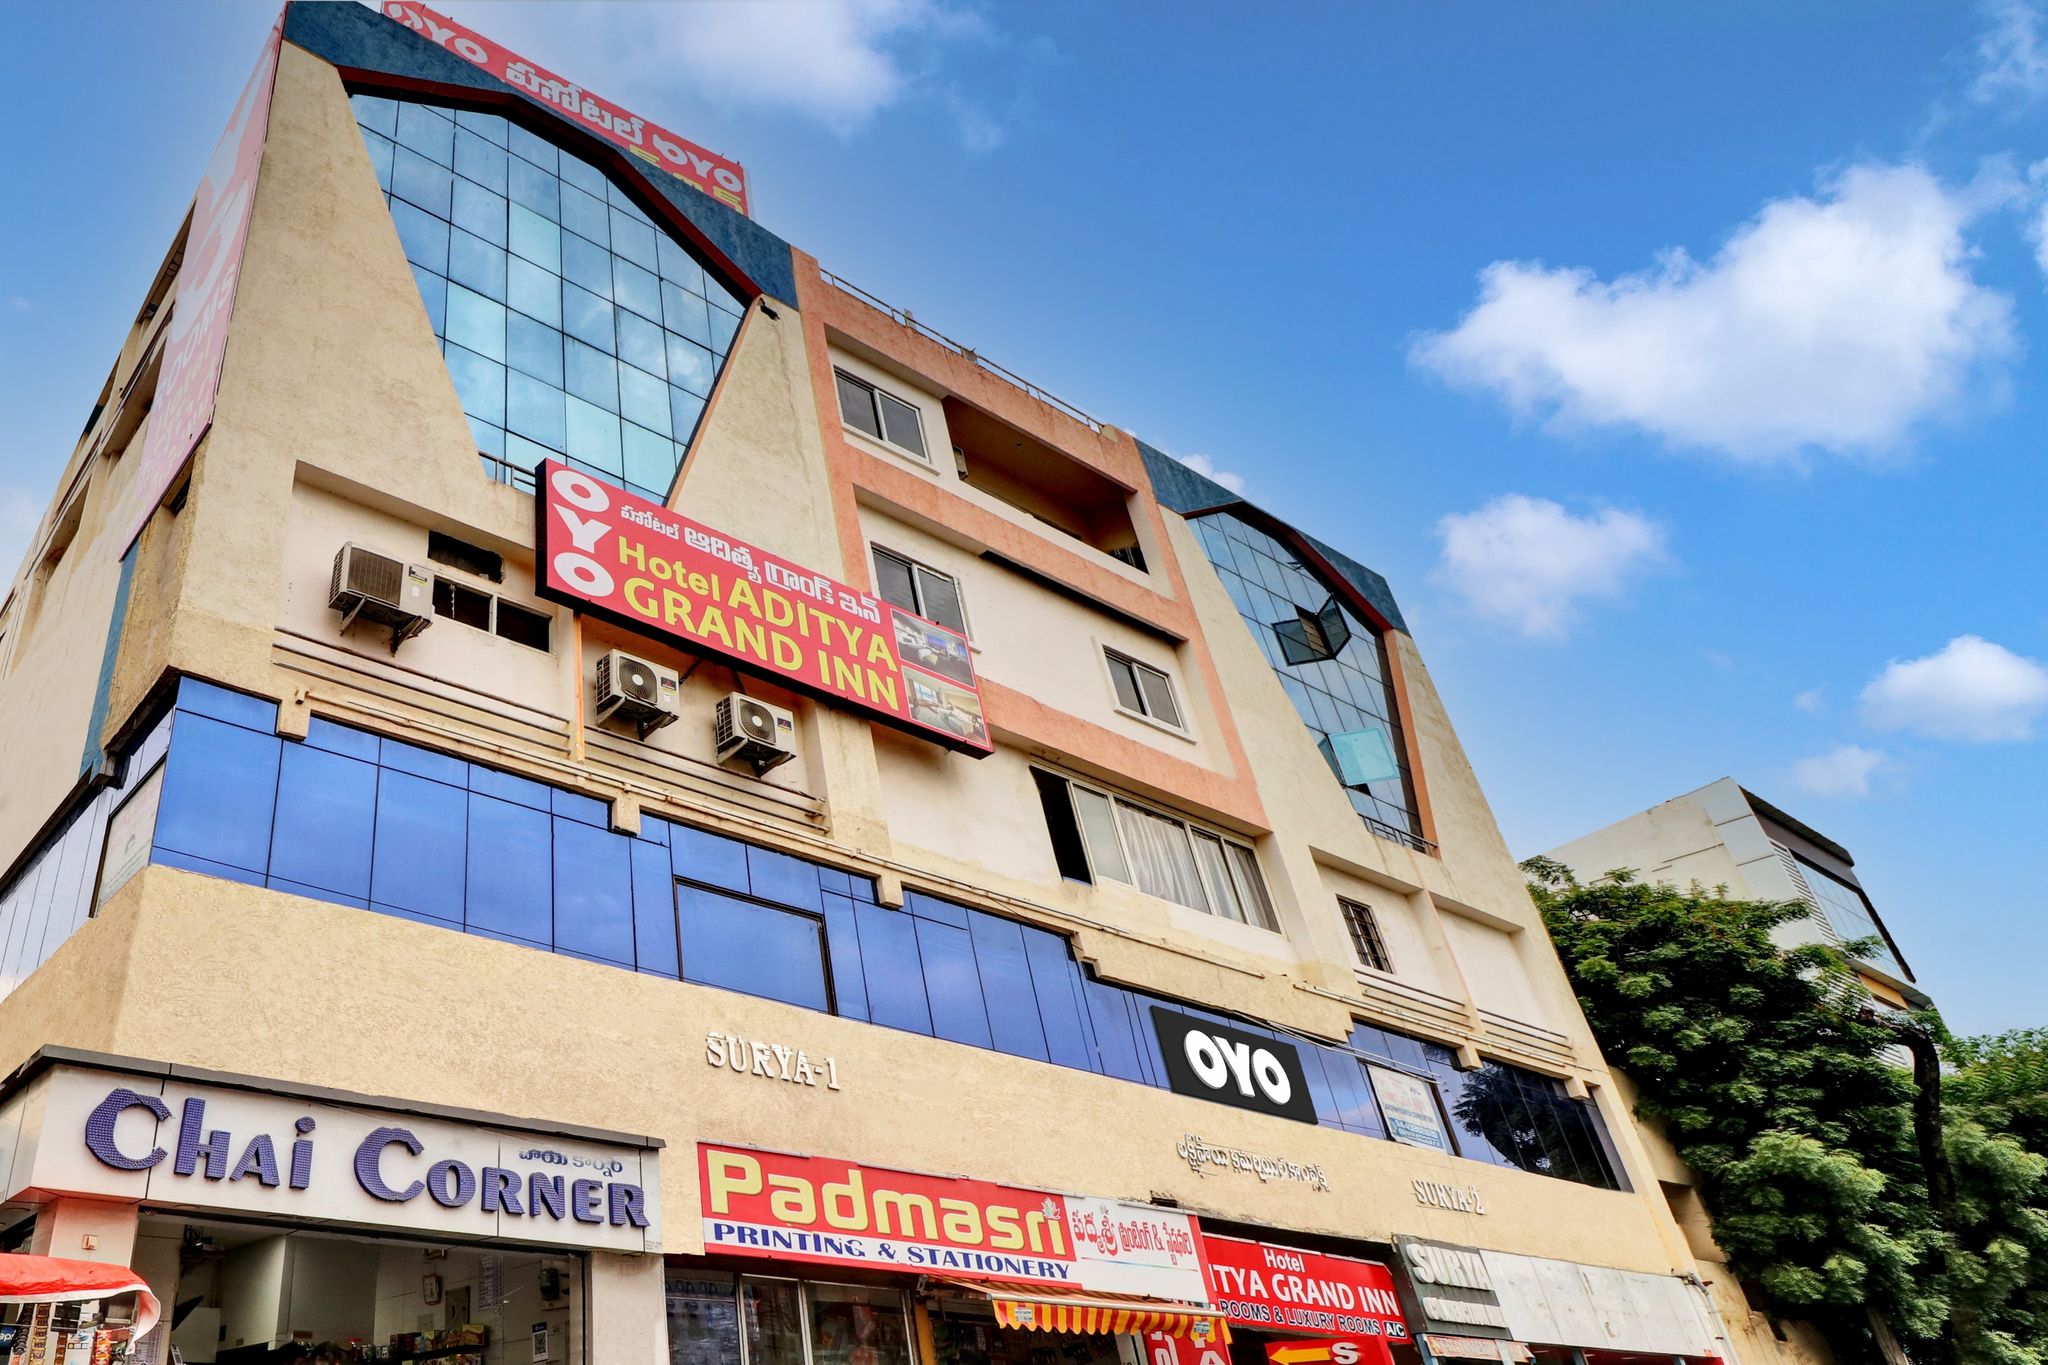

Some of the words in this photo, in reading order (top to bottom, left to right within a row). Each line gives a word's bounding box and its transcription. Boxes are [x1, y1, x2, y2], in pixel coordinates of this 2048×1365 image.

[653, 133, 743, 193] OYO
[551, 469, 615, 598] OYO
[684, 526, 763, 585] ఆదిత్య
[618, 535, 721, 602] Hotel
[728, 577, 899, 675] ADITYA
[623, 577, 804, 672] GRAND
[817, 648, 900, 712] INN
[705, 1031, 841, 1091] SURYA-1
[1183, 1028, 1292, 1105] OYO
[707, 1149, 1067, 1257] Padmasri
[713, 1222, 867, 1260] PRINTING
[877, 1242, 898, 1263] &
[908, 1247, 1070, 1281] STATIONERY
[1263, 1247, 1305, 1273] Hotel
[1406, 1243, 1493, 1292] SURYA
[1219, 1299, 1271, 1322] ROOMS
[1273, 1305, 1284, 1324] &
[1285, 1307, 1335, 1331] LUXURY
[1337, 1315, 1381, 1336] ROOMS
[1271, 1273, 1355, 1310] GRAND
[1357, 1285, 1401, 1317] INN
